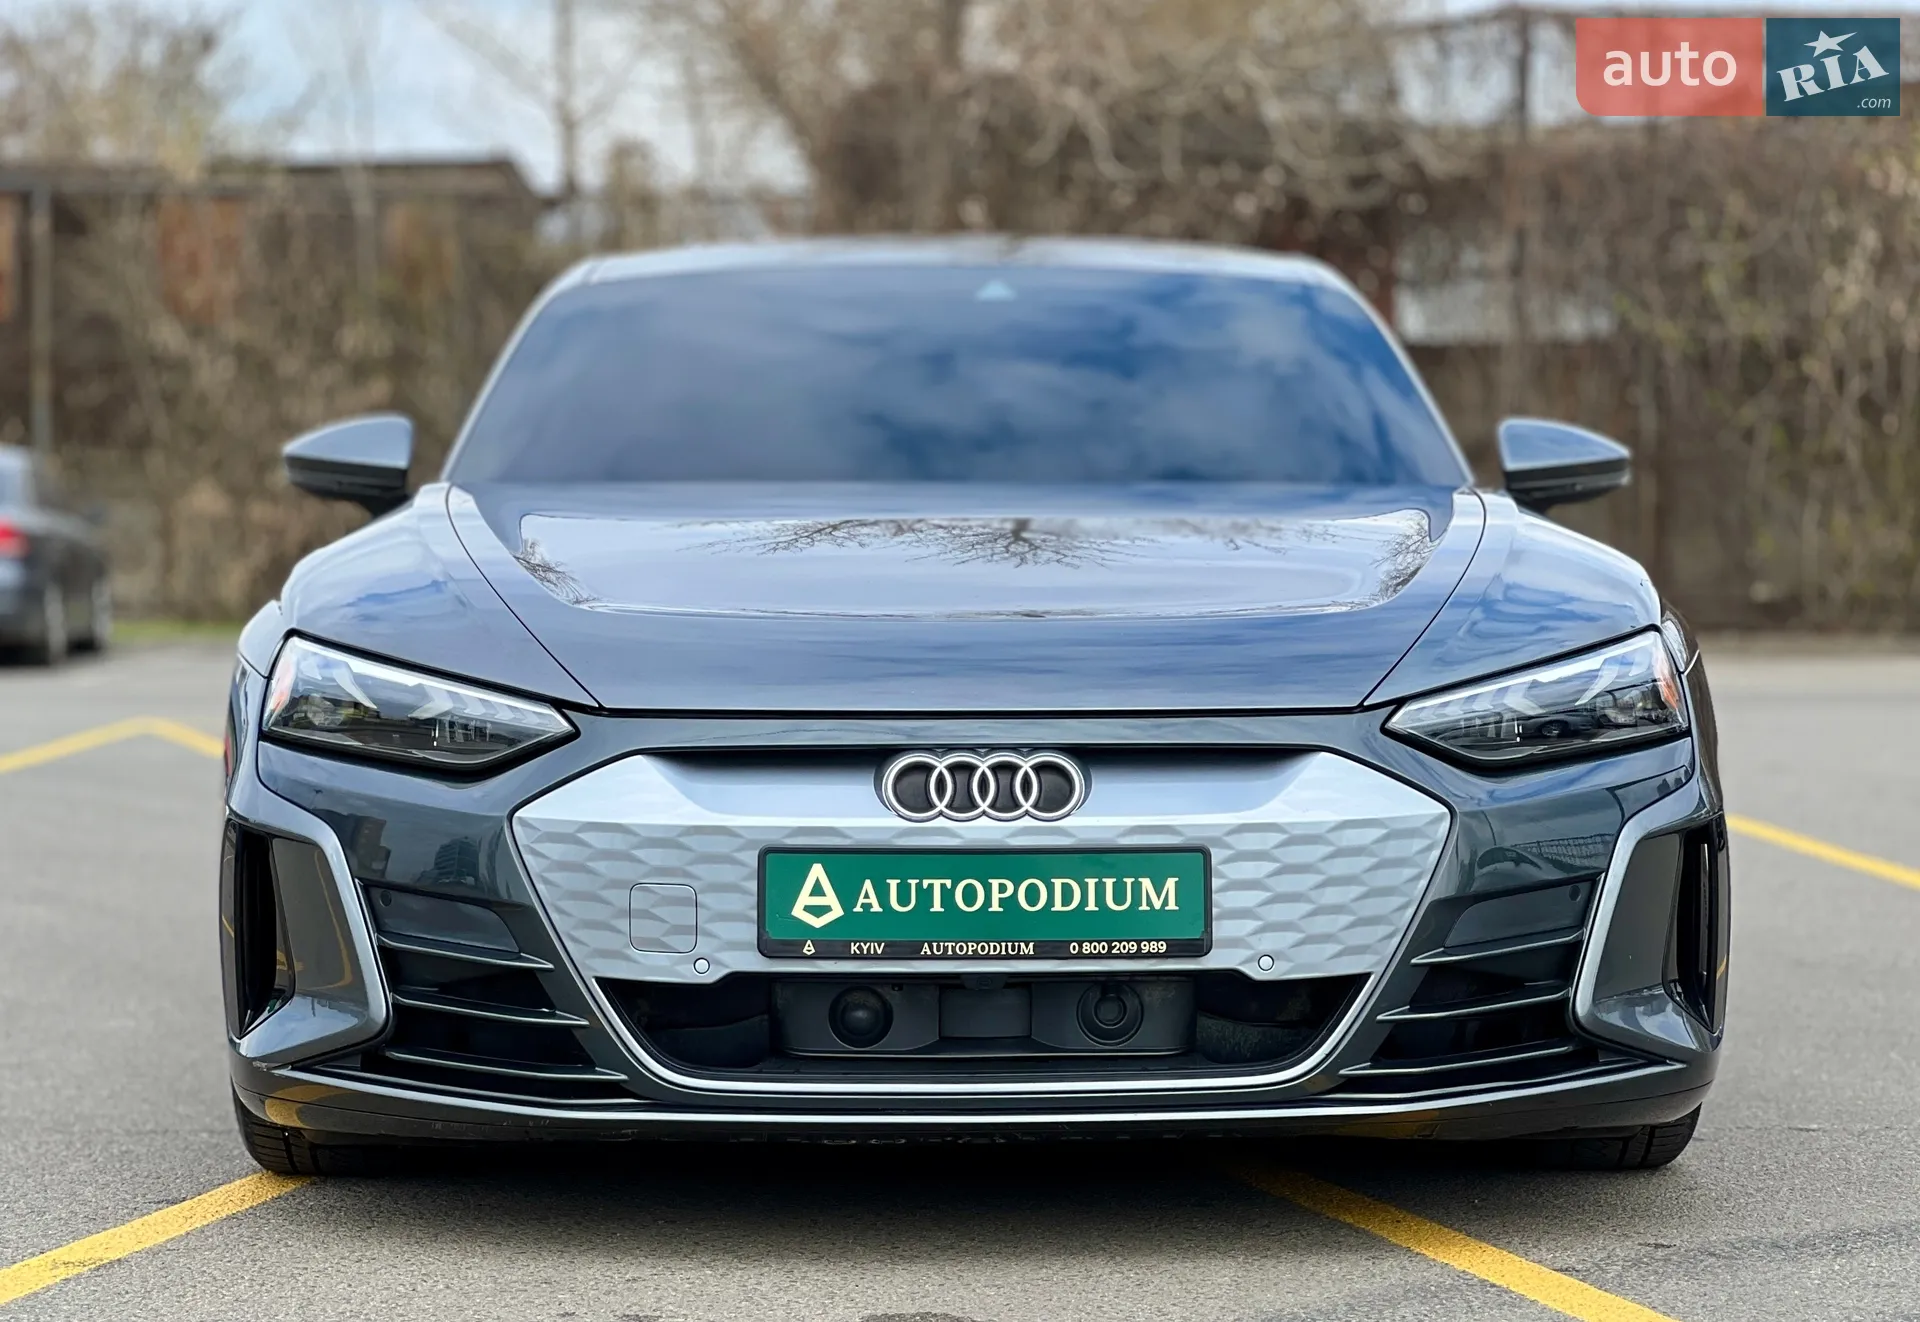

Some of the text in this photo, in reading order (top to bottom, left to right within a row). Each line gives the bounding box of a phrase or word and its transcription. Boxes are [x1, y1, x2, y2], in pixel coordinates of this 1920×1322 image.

[852, 877, 1180, 913] AUTOPODIUM
[850, 941, 1167, 955] KYIV AUTOPODIUM 0 800 209 989
